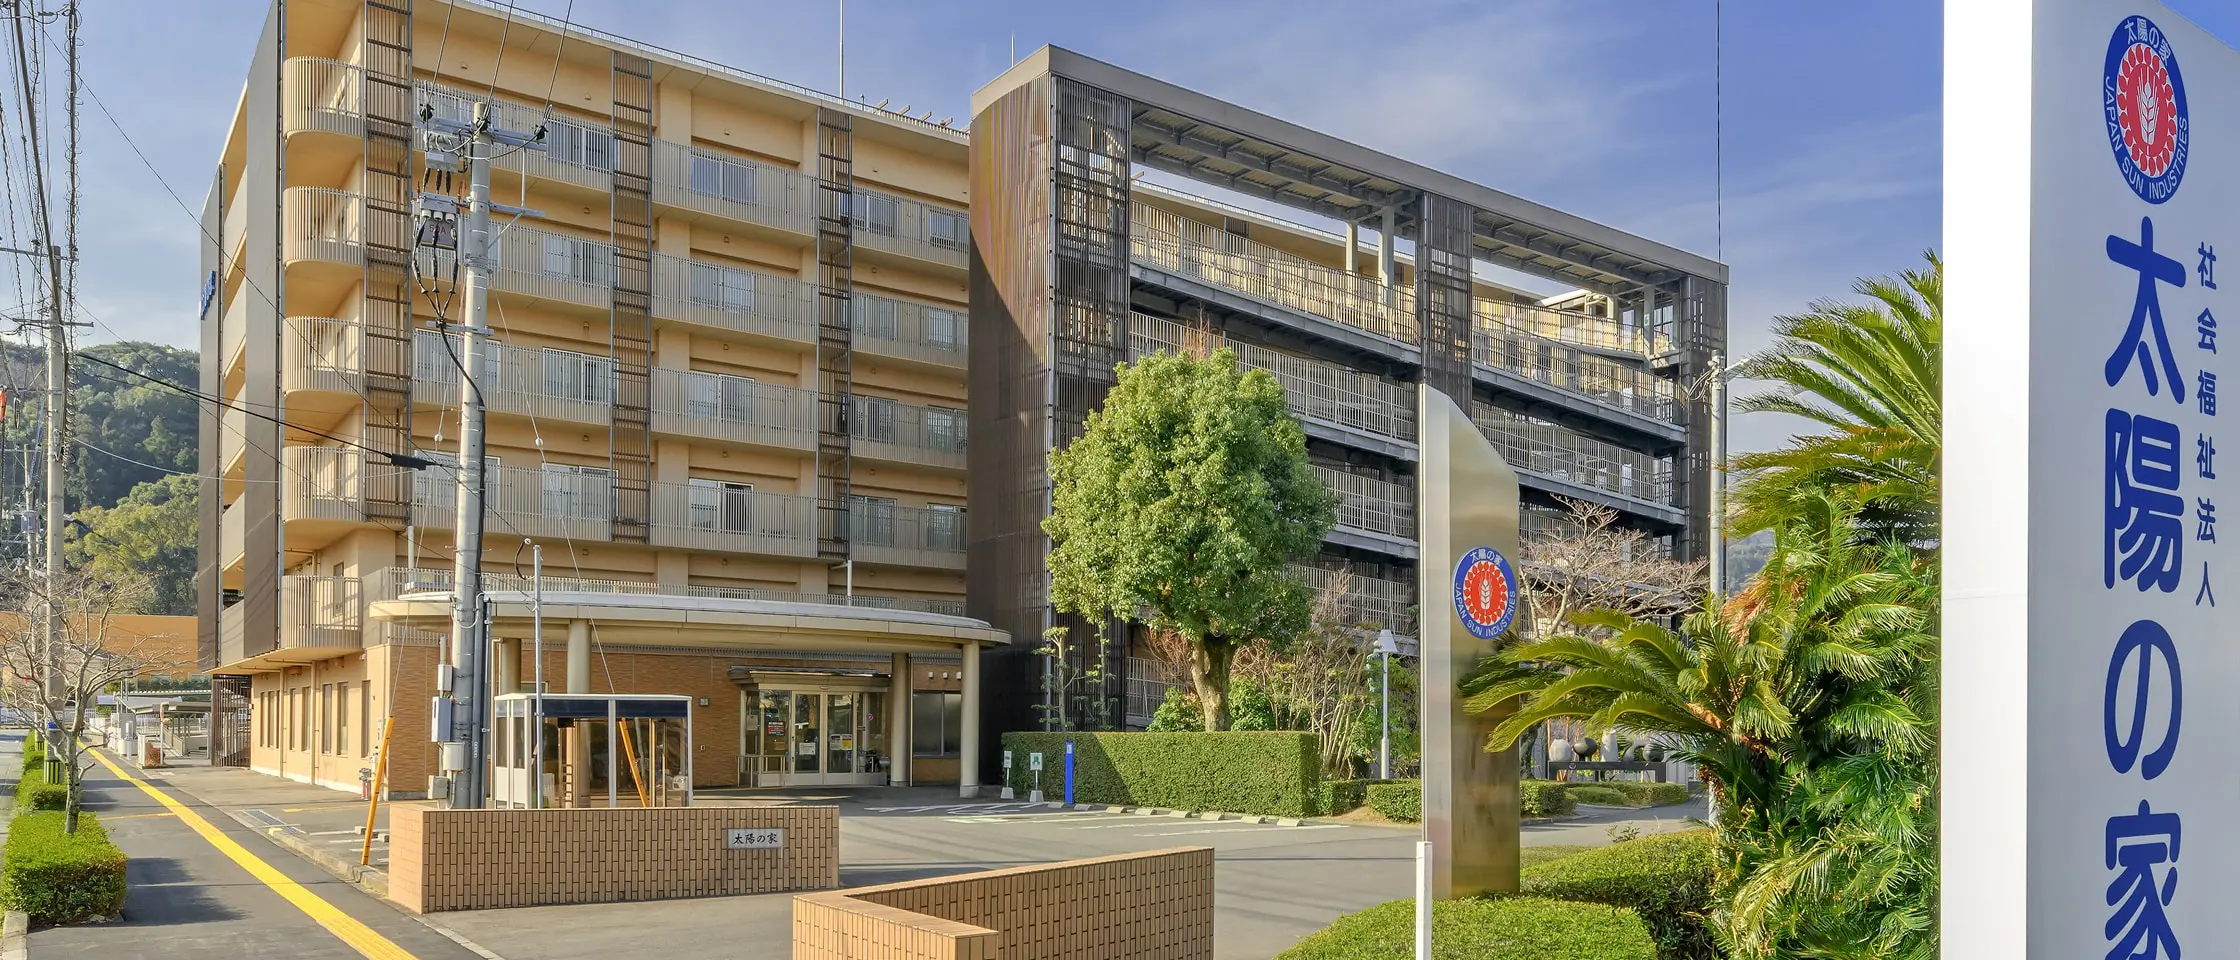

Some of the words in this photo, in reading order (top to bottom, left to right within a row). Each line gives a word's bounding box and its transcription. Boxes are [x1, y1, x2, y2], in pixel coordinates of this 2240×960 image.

[2125, 18, 2171, 66] 太陽の家
[2105, 77, 2122, 152] JAPAN
[2122, 157, 2144, 193] SUN
[2149, 117, 2188, 199] INDUSTRIES
[2196, 241, 2217, 607] 社会福祉法人
[1456, 583, 1467, 619] JAPAN
[1467, 620, 1482, 635] SUN
[1485, 590, 1516, 636] INDUSTRIES
[2104, 216, 2186, 960] 太陽の家
[733, 833, 778, 844] 太陽の家
